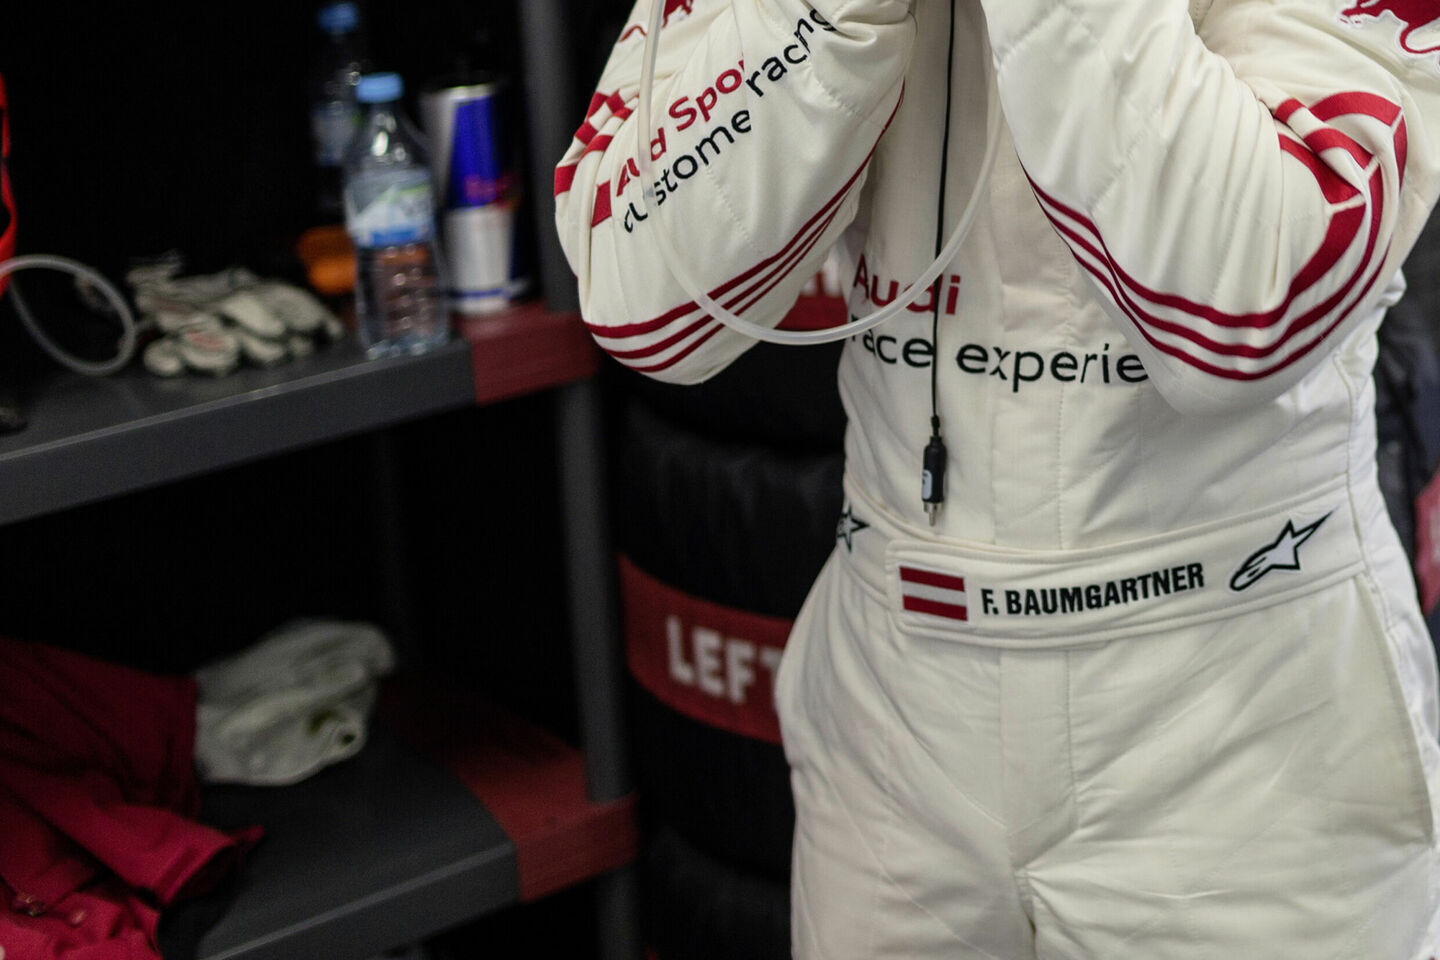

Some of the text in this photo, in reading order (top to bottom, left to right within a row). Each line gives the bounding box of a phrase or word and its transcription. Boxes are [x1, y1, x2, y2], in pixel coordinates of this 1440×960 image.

[956, 343, 1149, 393] experie
[981, 562, 1204, 616] F. BAUMGARTNER
